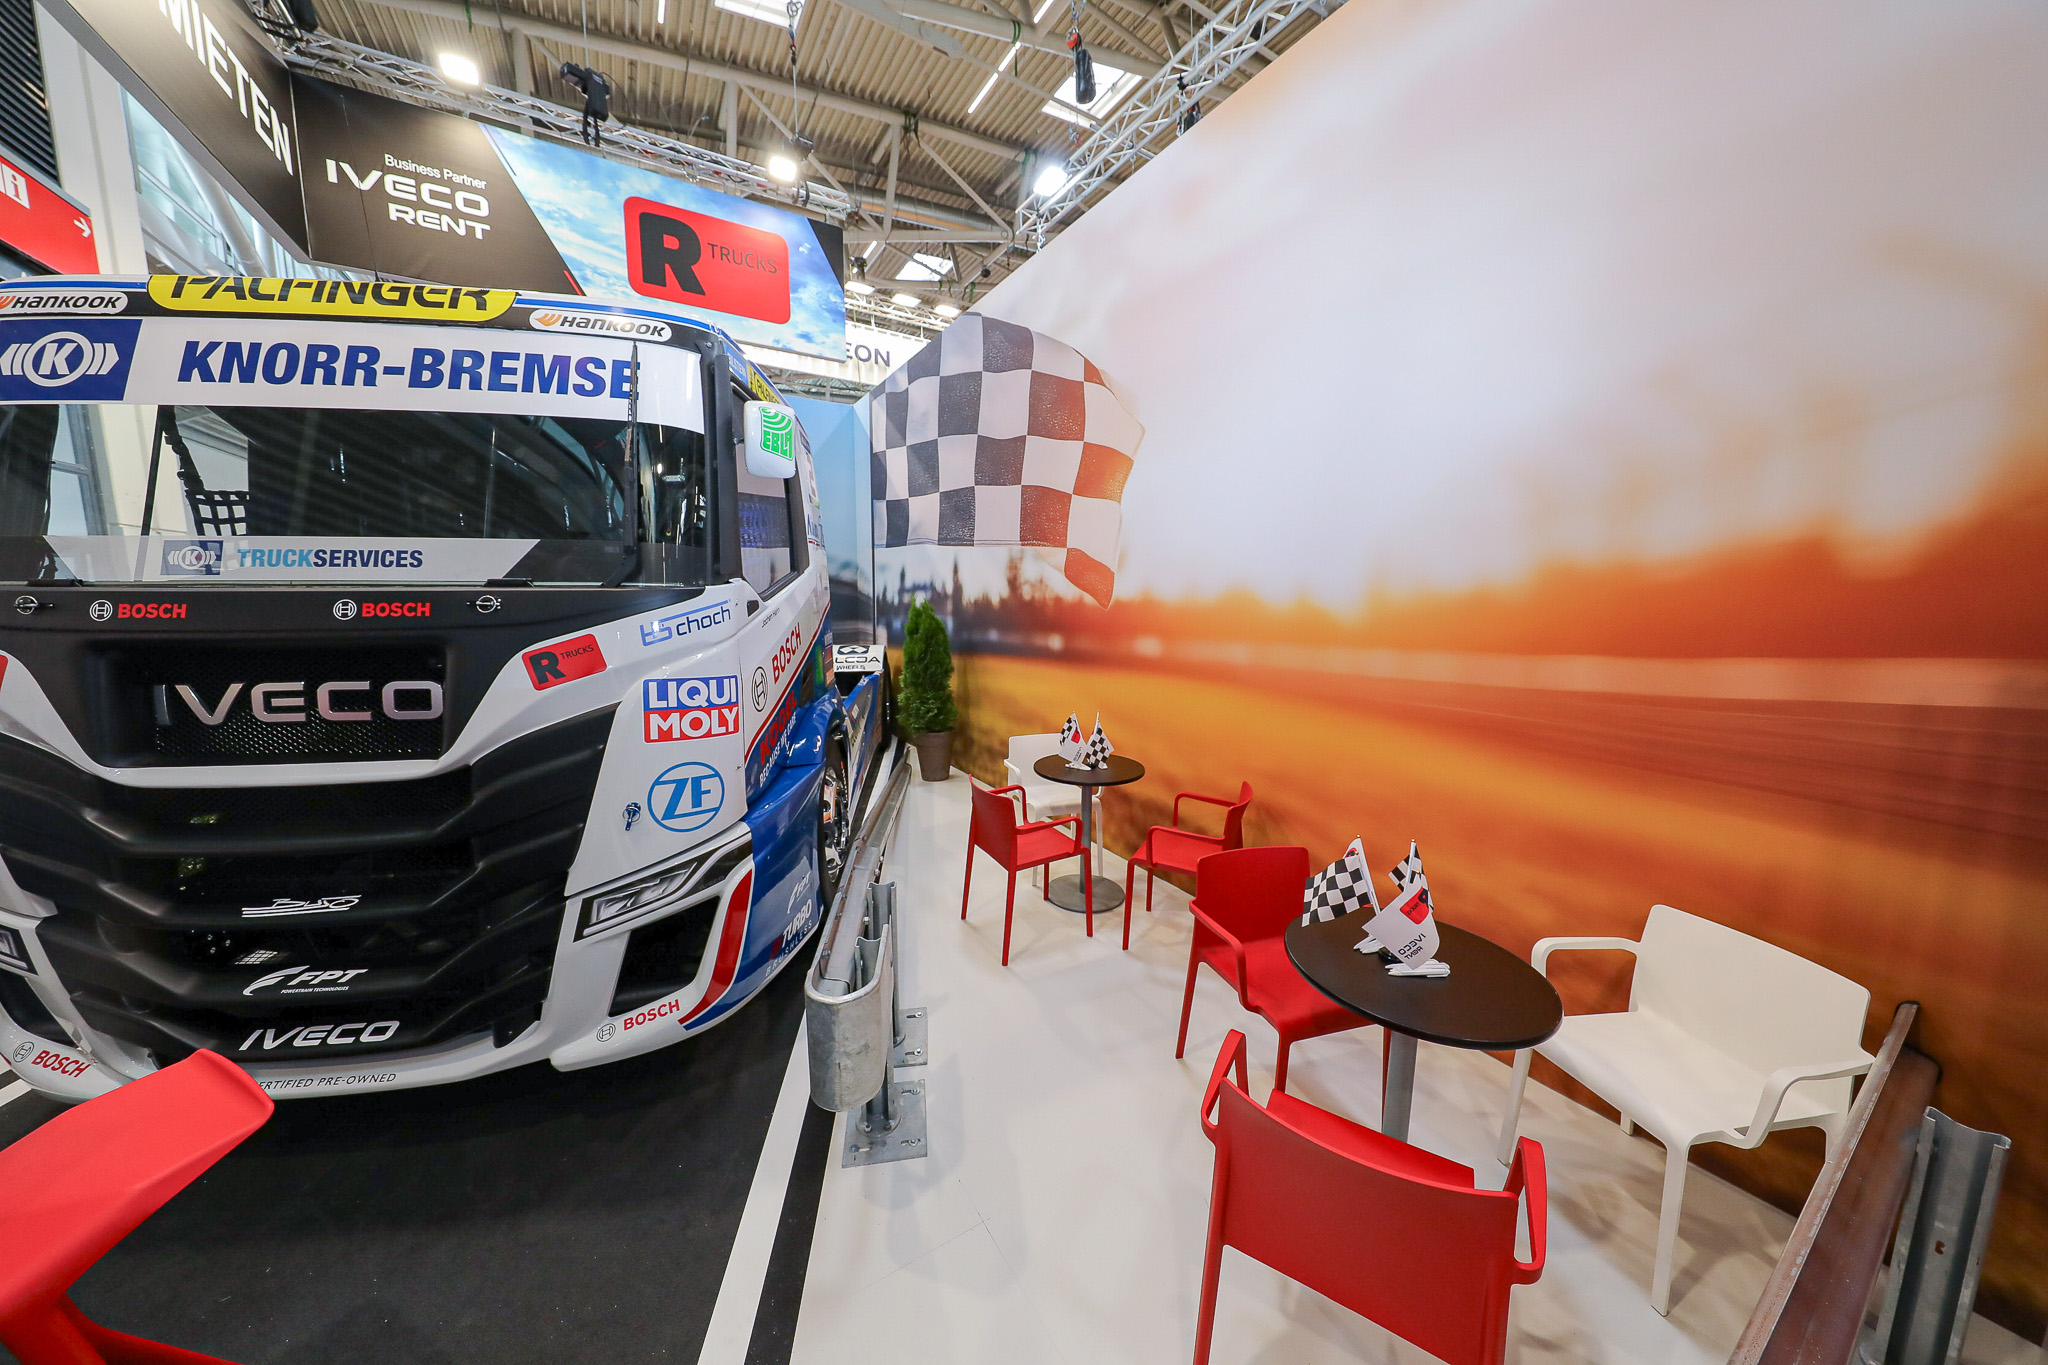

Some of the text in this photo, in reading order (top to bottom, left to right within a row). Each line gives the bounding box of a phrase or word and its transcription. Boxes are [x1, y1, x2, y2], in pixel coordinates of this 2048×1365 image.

[326, 158, 490, 218] IVECO
[384, 153, 487, 190] Business Partner
[387, 202, 491, 240] RENT
[639, 212, 778, 296] R TRUCKS
[177, 340, 641, 401] KNORR-BREMSE
[763, 429, 793, 459] EBLA
[237, 548, 424, 569] TRUCKSERVICES
[117, 603, 188, 619] BOSCH
[361, 602, 431, 618] BOSCH
[529, 645, 594, 684] R TRUCKS
[772, 622, 802, 684] BOSCH
[153, 680, 443, 726] IVECO
[649, 677, 738, 709] LIQUI
[650, 706, 739, 740] MOLY
[651, 772, 722, 822] ZF
[781, 898, 812, 948] TURBO
[765, 919, 812, 977] BRUSHLESS
[287, 969, 368, 986] FPT
[313, 985, 349, 993] TECHNOLOGIES
[624, 999, 680, 1031] BOSCH
[239, 1020, 400, 1051] IVECO
[31, 1050, 91, 1078] BOSCH
[259, 1073, 397, 1091] ERTIFIED PRE-OWNED
